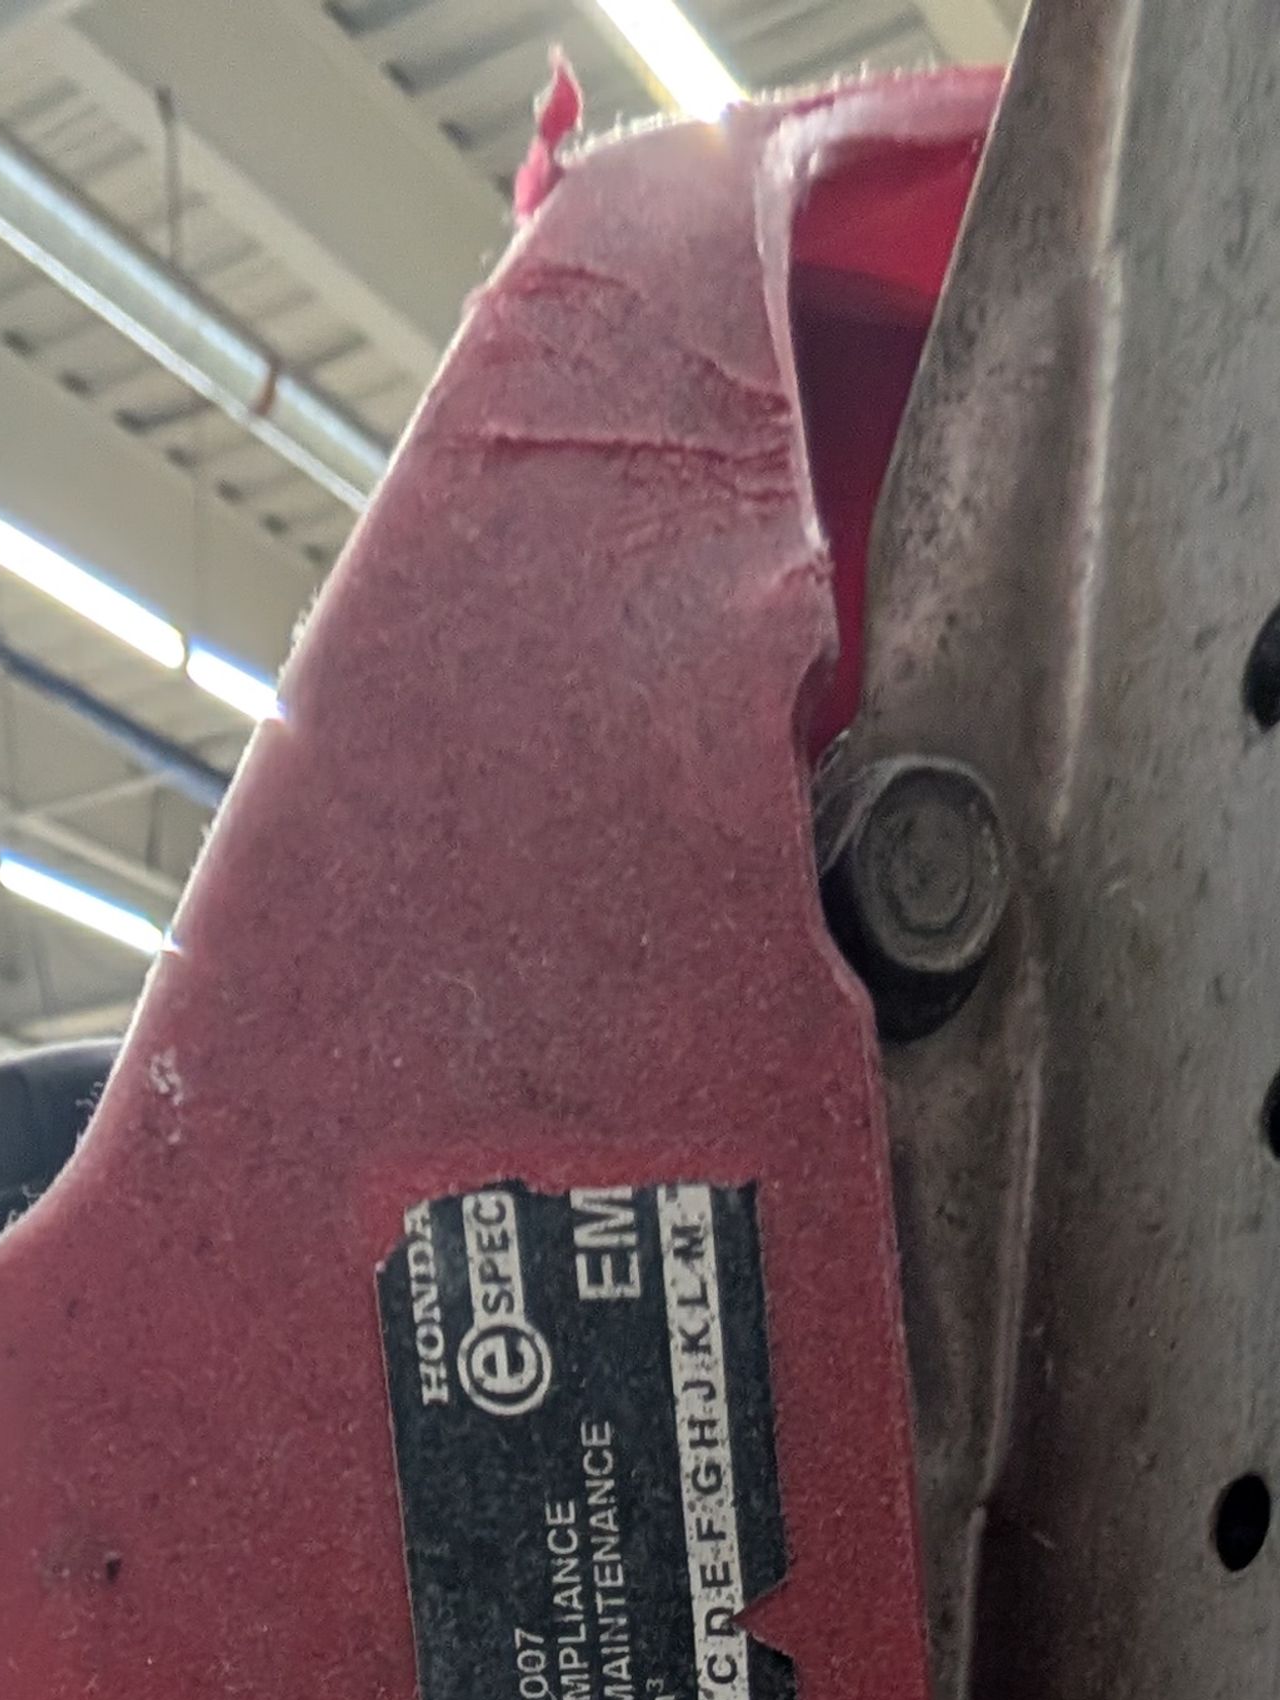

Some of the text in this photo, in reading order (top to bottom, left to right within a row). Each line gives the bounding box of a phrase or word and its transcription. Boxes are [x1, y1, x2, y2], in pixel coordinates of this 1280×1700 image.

[670, 1224, 705, 1260] M
[472, 1200, 514, 1315] SPEC
[403, 1200, 448, 1405] HONDA
[674, 1281, 708, 1309] L
[677, 1322, 710, 1355] K
[682, 1379, 716, 1403] J
[688, 1419, 720, 1448] H
[690, 1464, 723, 1496] G
[694, 1517, 727, 1542] F
[699, 1561, 731, 1588] E
[704, 1606, 735, 1637] D
[706, 1654, 737, 1684] C
